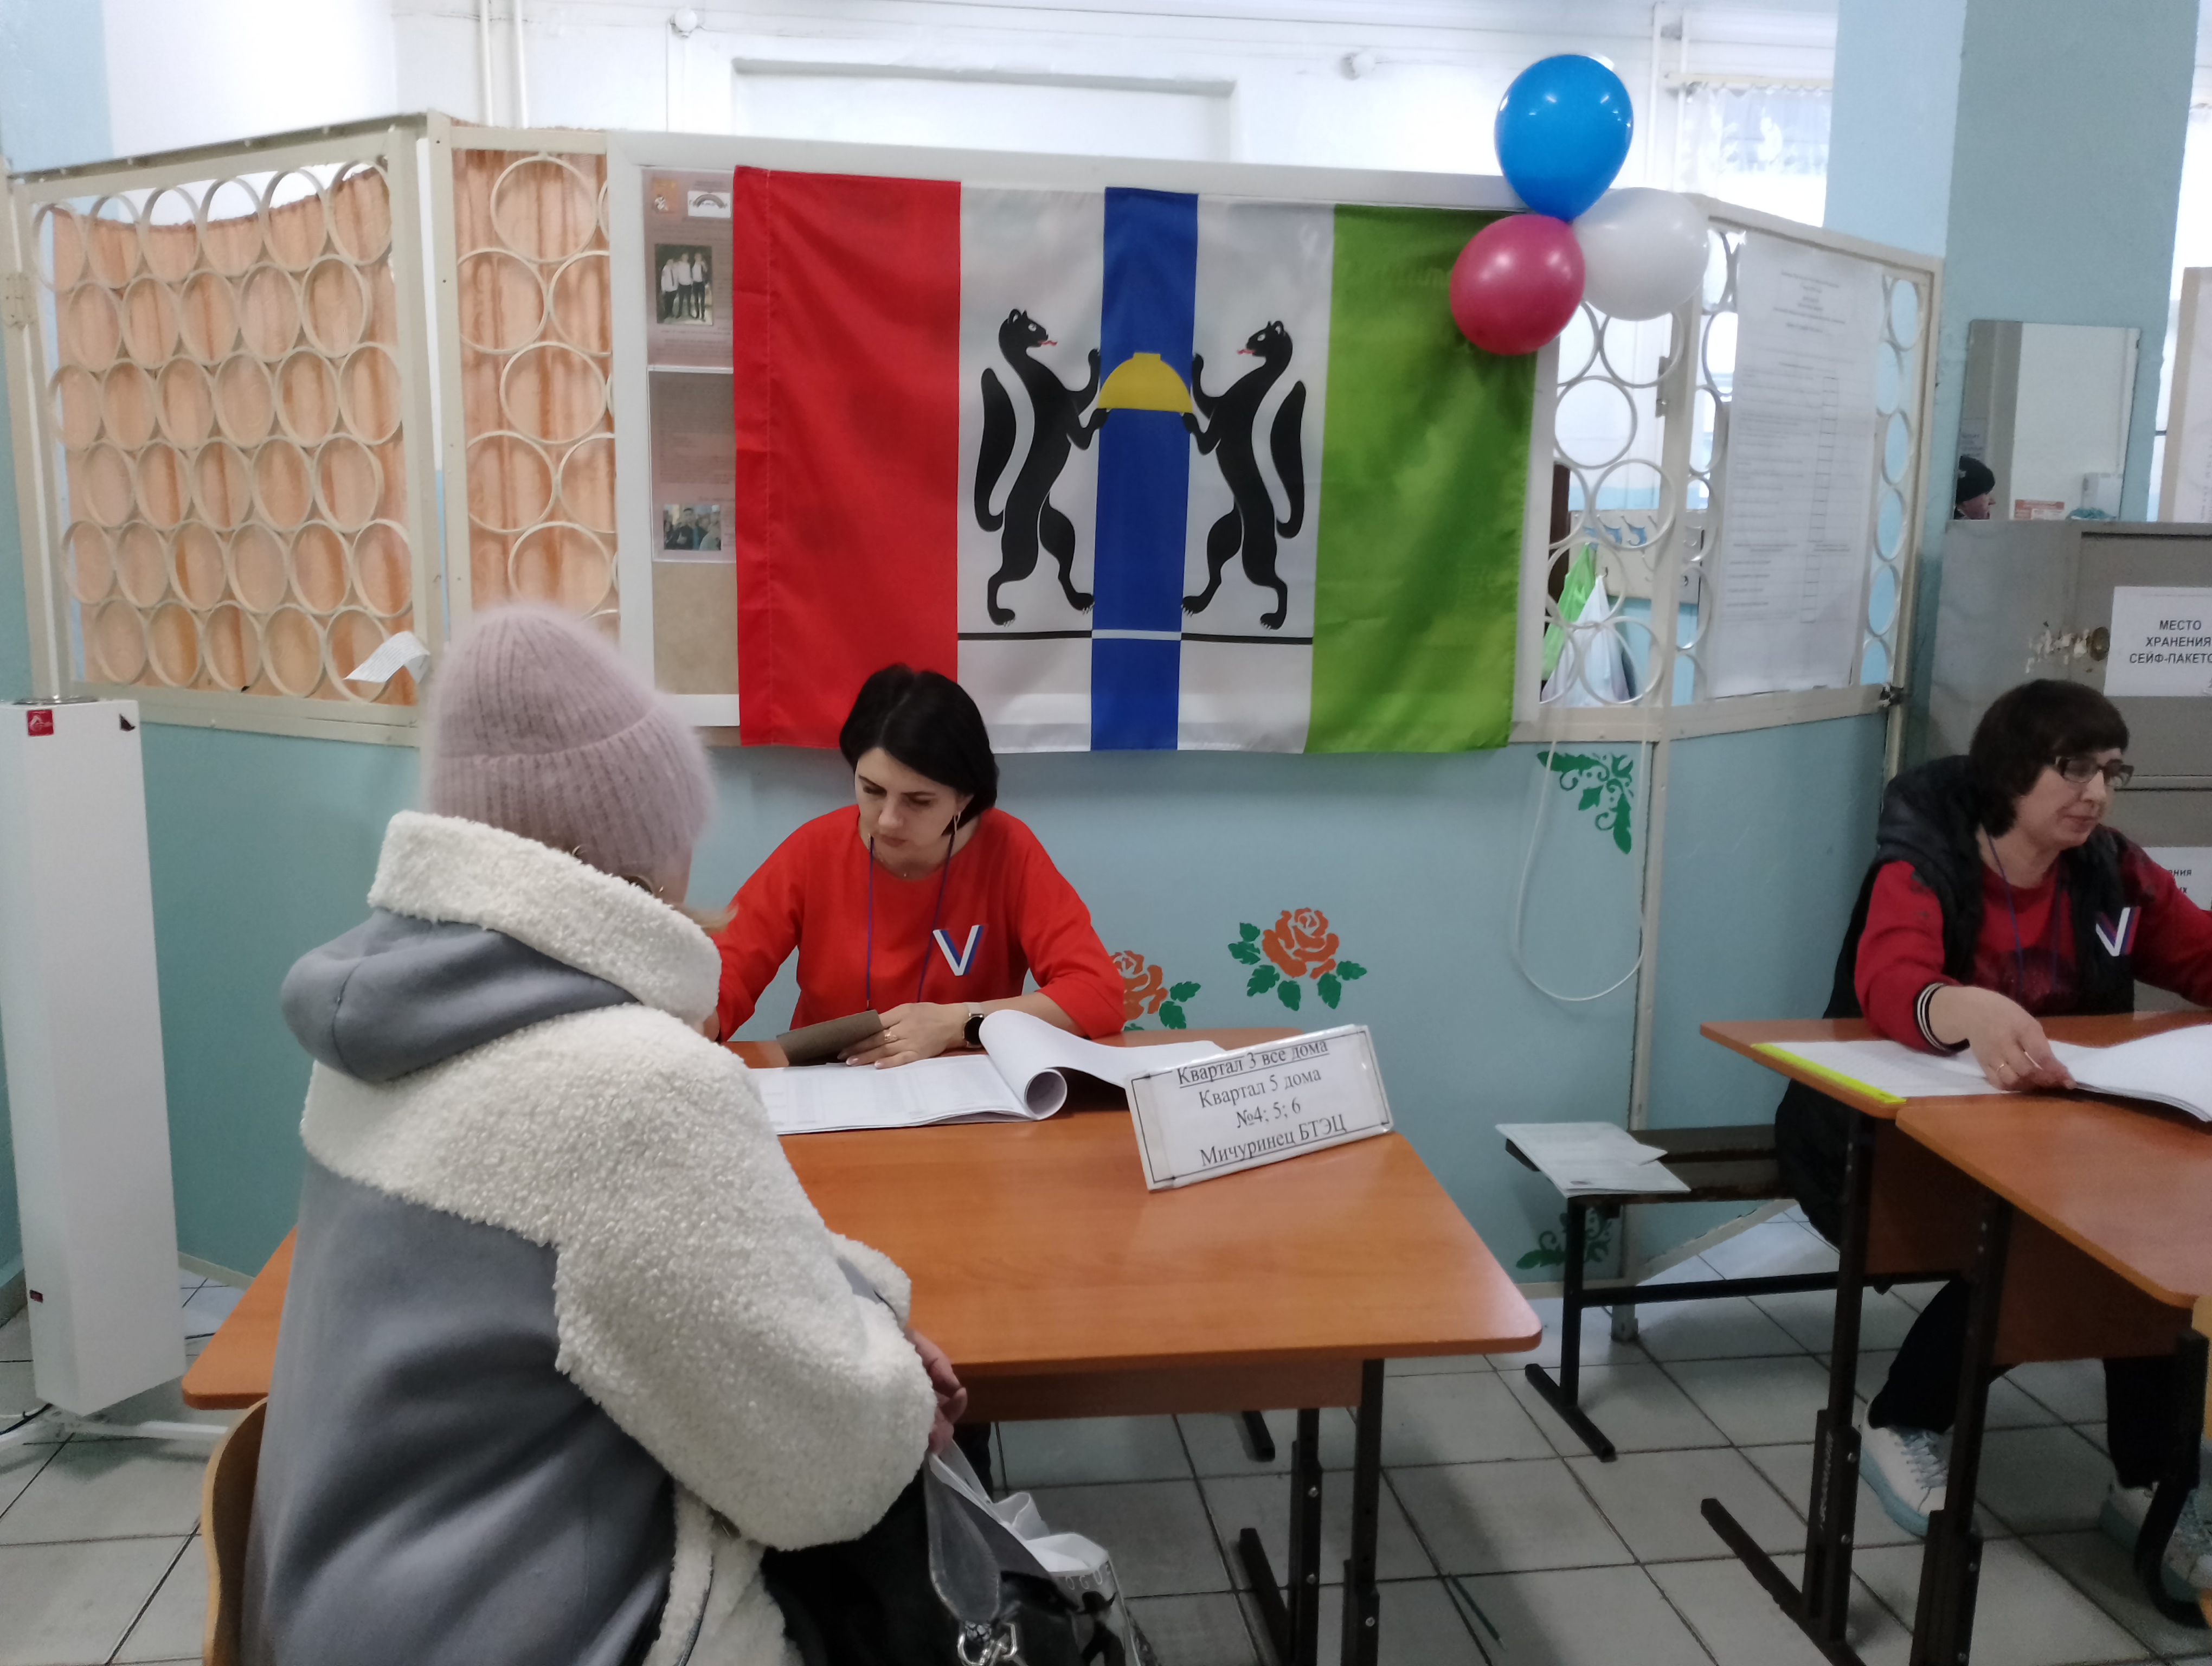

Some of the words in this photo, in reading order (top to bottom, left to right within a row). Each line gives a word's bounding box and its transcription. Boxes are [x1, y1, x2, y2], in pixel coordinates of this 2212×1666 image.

[2159, 620, 2202, 630] МЕСТО
[2145, 637, 2211, 647] ХРАНЕНИЯ
[1176, 1059, 1244, 1085] Квартал
[1246, 1052, 1257, 1069] 3
[1261, 1049, 1287, 1066] все
[1291, 1040, 1329, 1061] дома
[1199, 1080, 1266, 1108] Квартал
[1270, 1074, 1279, 1092] 5
[1284, 1068, 1322, 1091] дома
[1291, 1097, 1301, 1114] 6
[1200, 1130, 1295, 1167] Мичуринец
[1298, 1113, 1347, 1141] БТЭЦ
